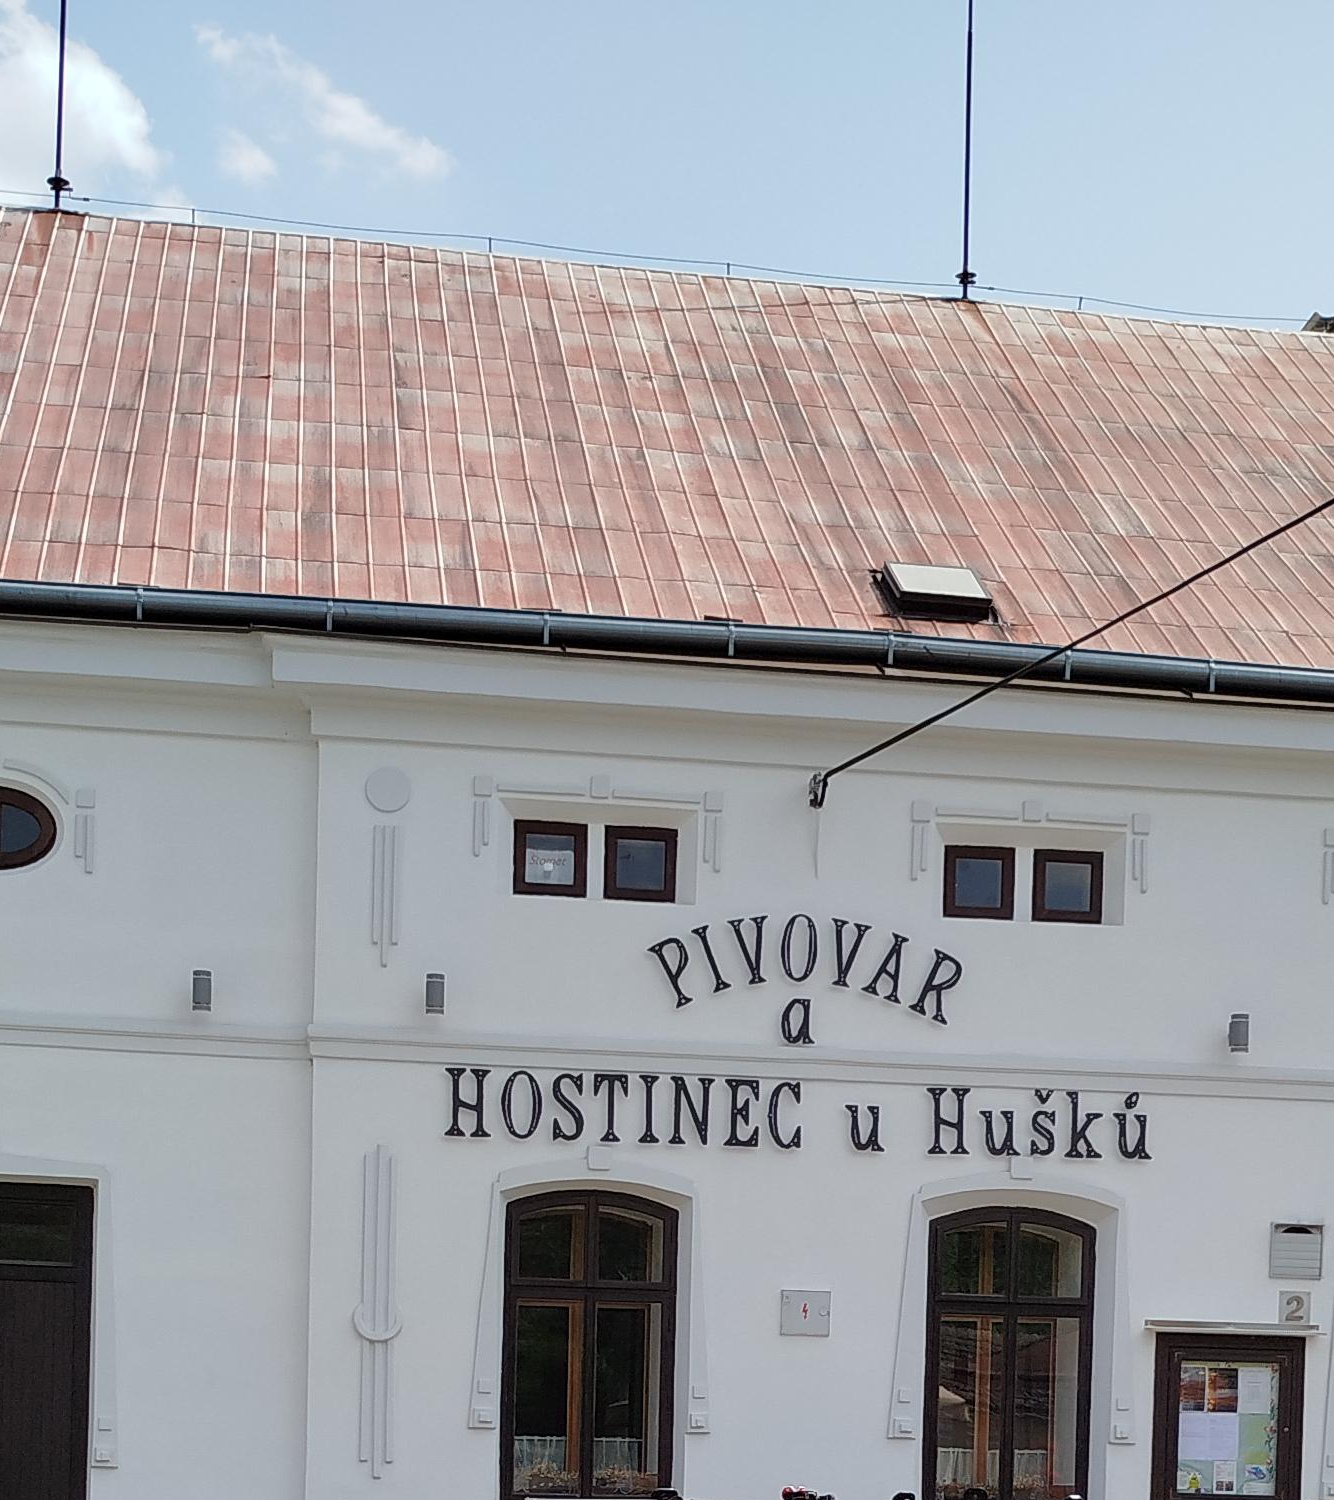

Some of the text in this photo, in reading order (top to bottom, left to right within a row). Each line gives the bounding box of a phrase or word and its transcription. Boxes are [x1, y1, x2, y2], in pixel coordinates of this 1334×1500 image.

[646, 913, 964, 1026] PIVOVAR
[780, 997, 814, 1045] a
[443, 1066, 804, 1150] HOSTINEC
[844, 1103, 885, 1154] u
[1283, 1294, 1306, 1323] 2
